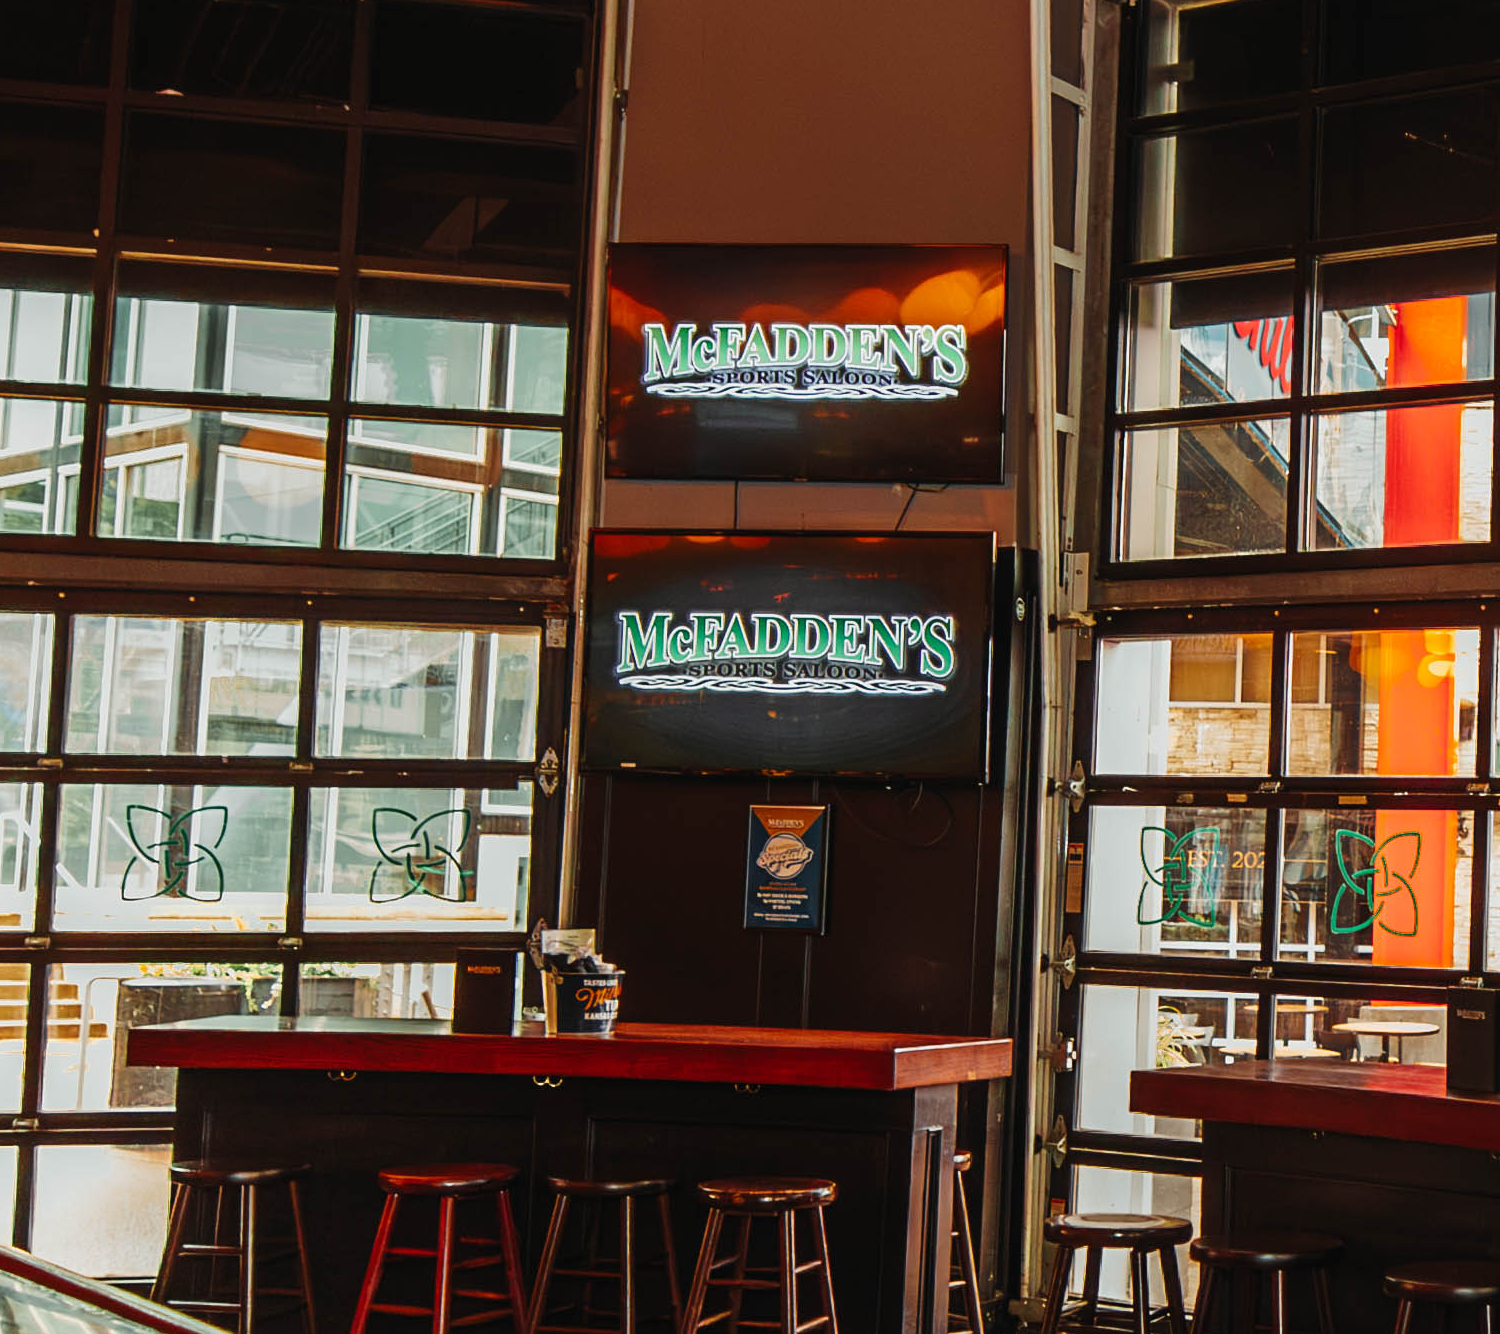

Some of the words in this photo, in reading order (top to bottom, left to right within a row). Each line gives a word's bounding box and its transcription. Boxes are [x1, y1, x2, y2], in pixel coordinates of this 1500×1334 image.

[642, 321, 969, 385] McFADDEN'S
[711, 369, 797, 387] SPORTS
[802, 369, 895, 386] SALOON
[616, 610, 957, 679] McFADDEN'S
[688, 662, 777, 679] SPORTS
[782, 662, 878, 681] SALOON
